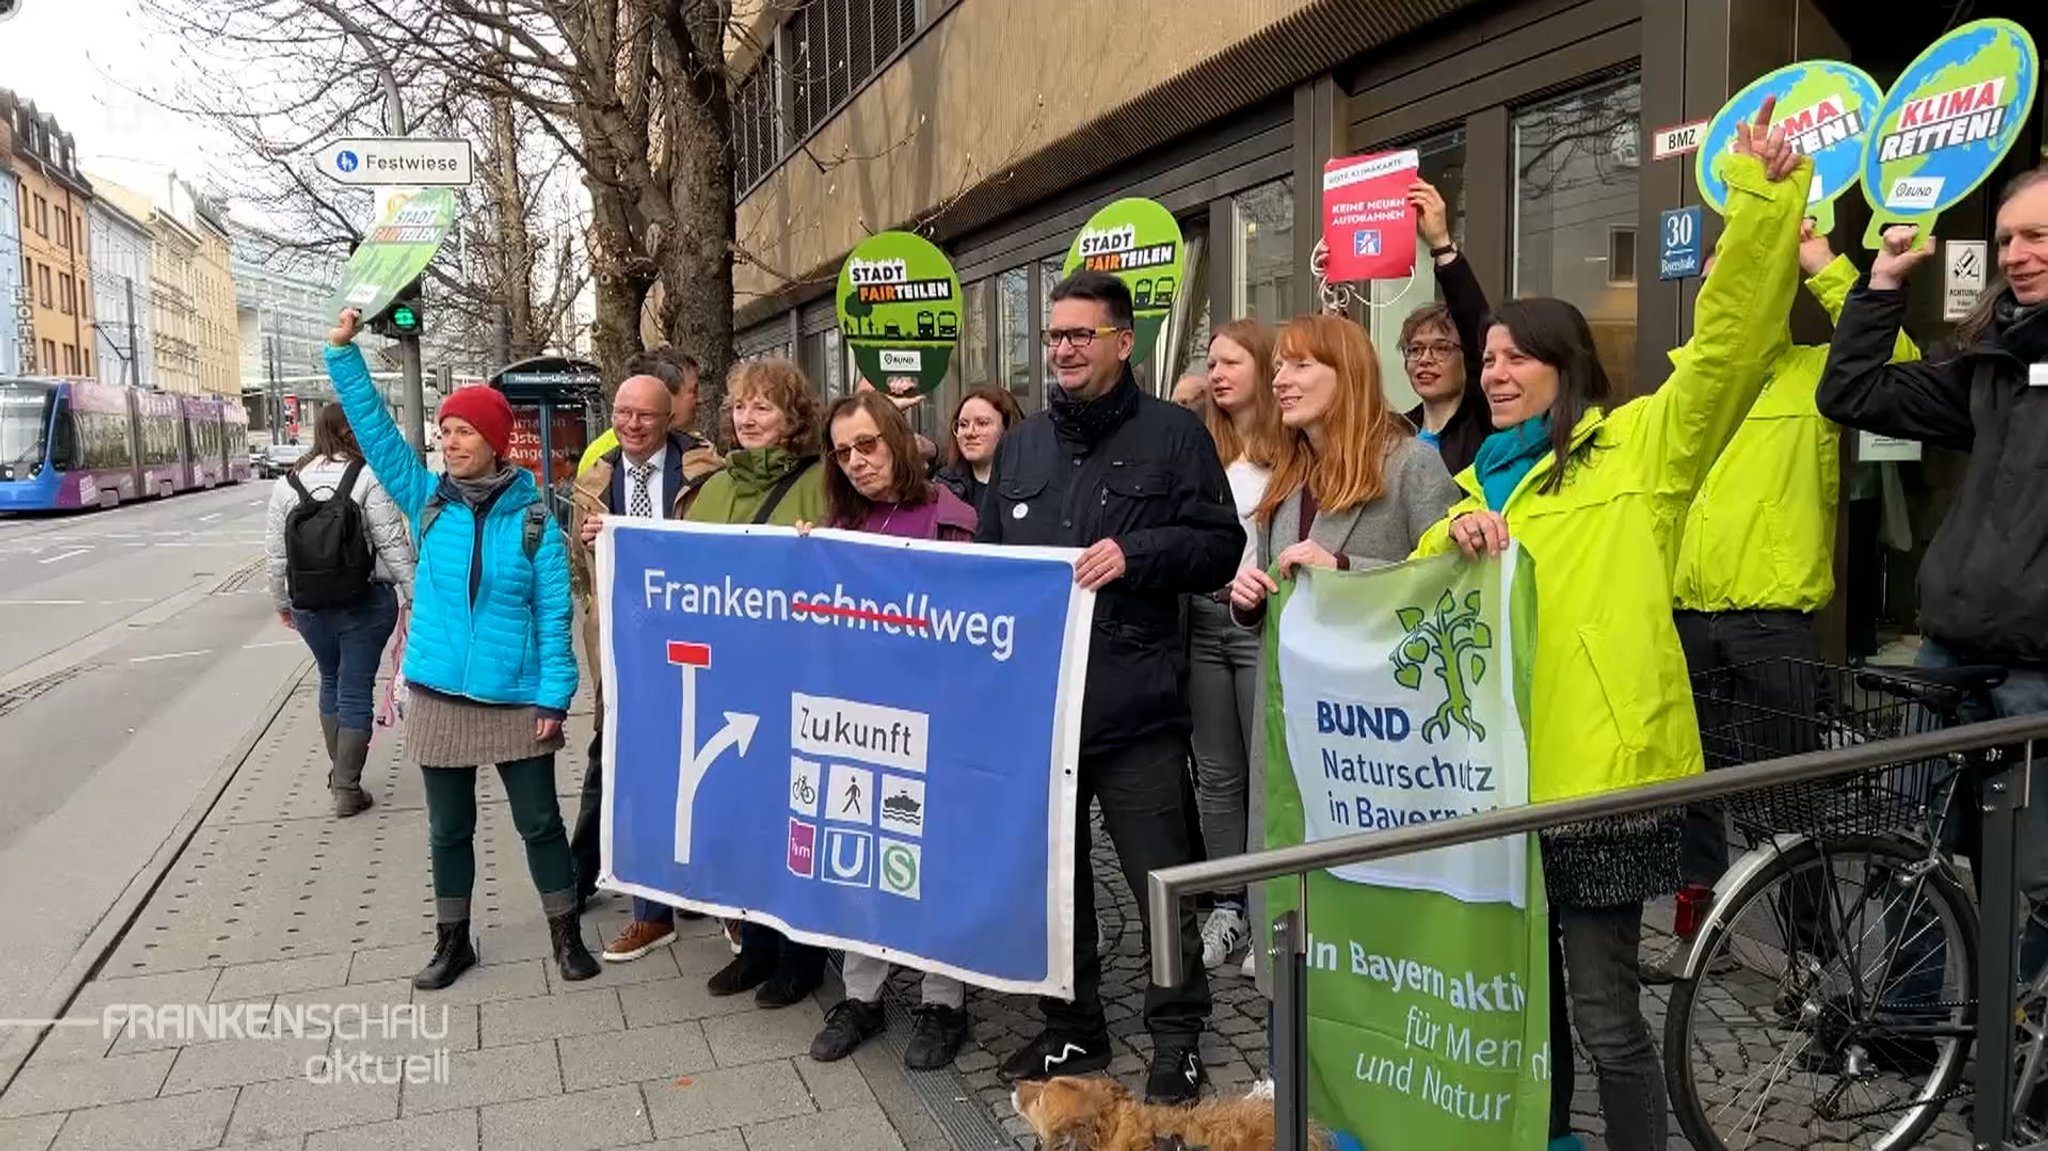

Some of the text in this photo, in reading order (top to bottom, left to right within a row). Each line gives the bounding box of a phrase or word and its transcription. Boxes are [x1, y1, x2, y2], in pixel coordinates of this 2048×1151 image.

[1784, 101, 1839, 137] MA
[1901, 82, 1995, 129] KLIMA
[1668, 129, 1696, 149] BMZ
[1788, 113, 1861, 155] TEN!
[1880, 107, 2004, 163] RETTEN!
[366, 154, 458, 171] Festwiese
[1332, 198, 1405, 214] KEINE NEUEN
[1905, 187, 1932, 197] BUND
[1331, 210, 1405, 226] AUTOBAHNEN
[1666, 213, 1692, 247] 30
[1081, 231, 1132, 253] STADT
[1086, 245, 1173, 271] FAIRTEILEN
[852, 265, 904, 282] STADT
[860, 282, 949, 300] FAIRTEILEN
[509, 432, 542, 444] Oste
[644, 568, 1015, 661] Frankenschnellweg
[801, 706, 911, 756] Zukunft
[1317, 701, 1410, 742] BUND
[1322, 748, 1495, 792] Naturschutz
[1328, 790, 1350, 826] in
[831, 834, 865, 877] U
[888, 850, 911, 888] S
[1306, 933, 1337, 971] In
[1350, 940, 1445, 999] Bayern
[1404, 1005, 1441, 1049] für
[1446, 1023, 1522, 1067] Men
[1355, 1052, 1512, 1121] und Natur
